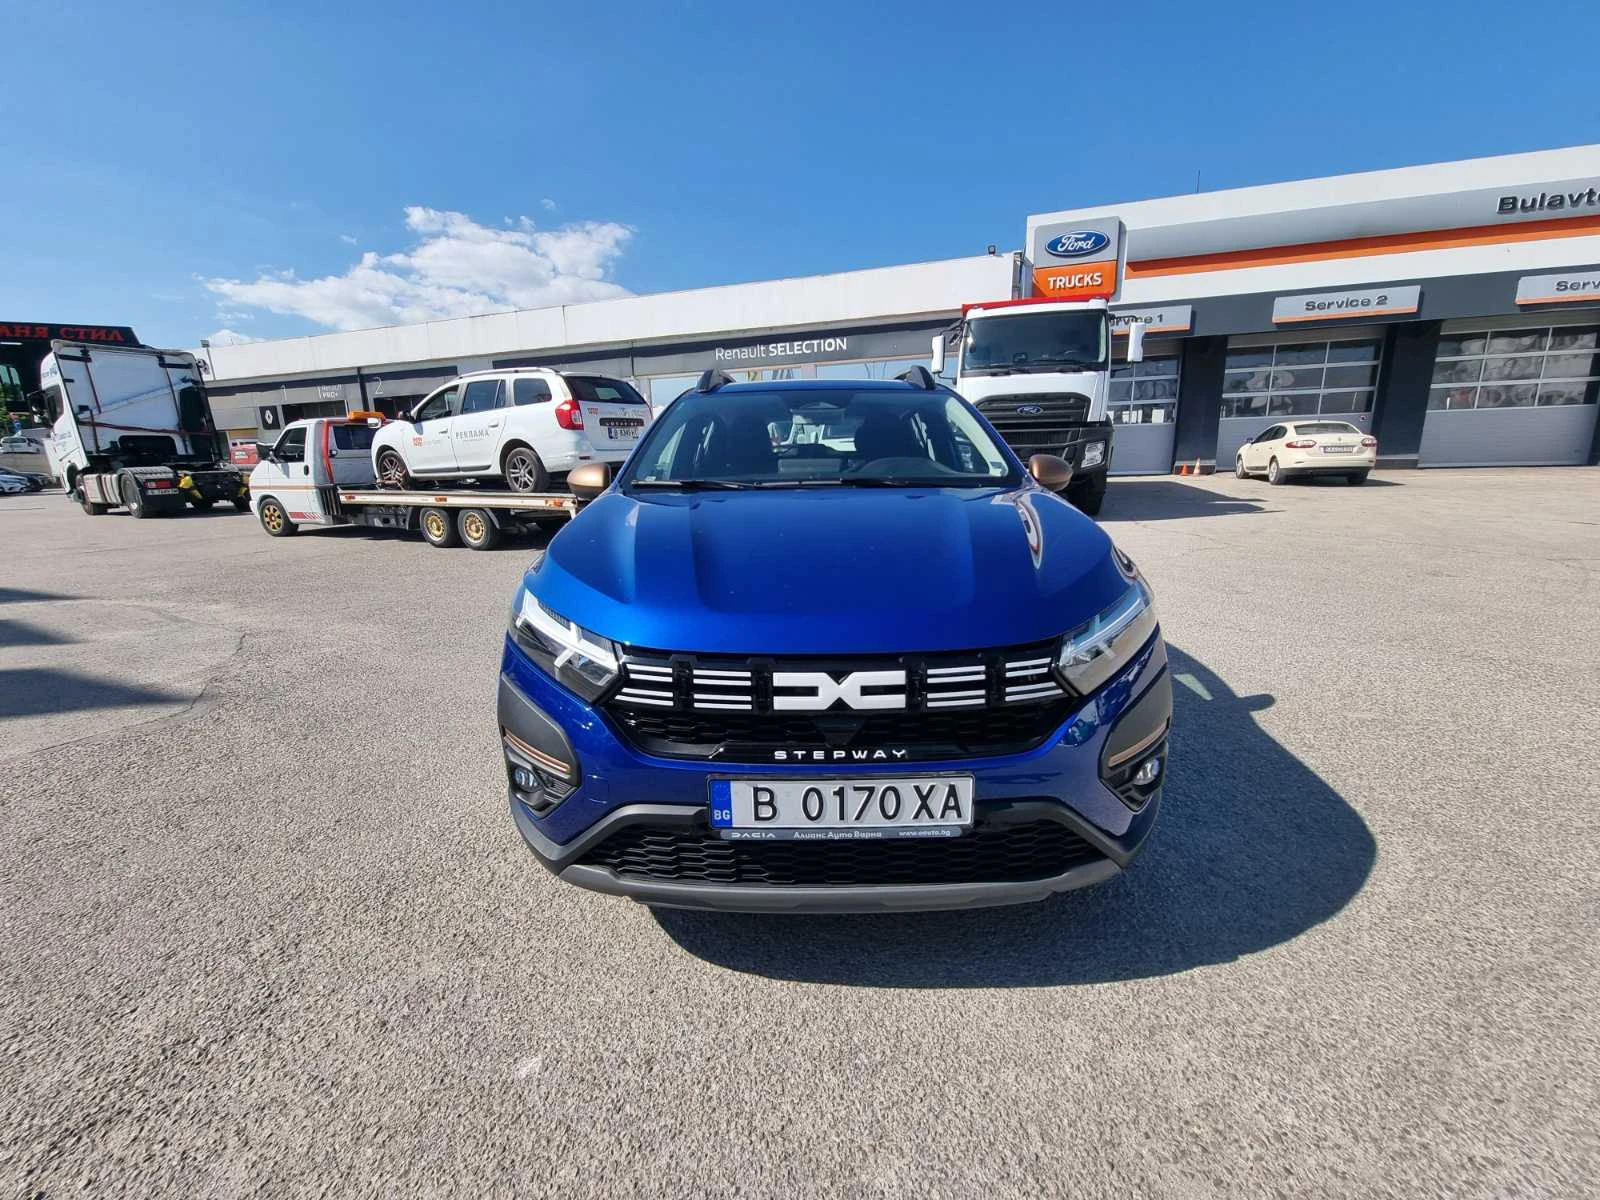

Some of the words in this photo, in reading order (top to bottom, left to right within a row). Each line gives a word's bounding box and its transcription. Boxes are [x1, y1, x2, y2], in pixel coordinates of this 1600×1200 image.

[1496, 187, 1600, 215] Bulavt
[1057, 233, 1096, 254] Ford
[1047, 271, 1103, 290] TRUCKS
[1304, 296, 1371, 312] Service
[1375, 294, 1388, 306] 2
[1156, 313, 1164, 323] 1
[59, 326, 125, 342] СТИЛ
[715, 344, 766, 361] Renault
[767, 338, 848, 357] SELECTION
[773, 749, 907, 761] STEPWAY
[752, 785, 779, 822] B
[801, 784, 901, 823] 0170
[911, 783, 962, 820] XA
[713, 808, 731, 821] BG
[731, 831, 776, 839] DACIA
